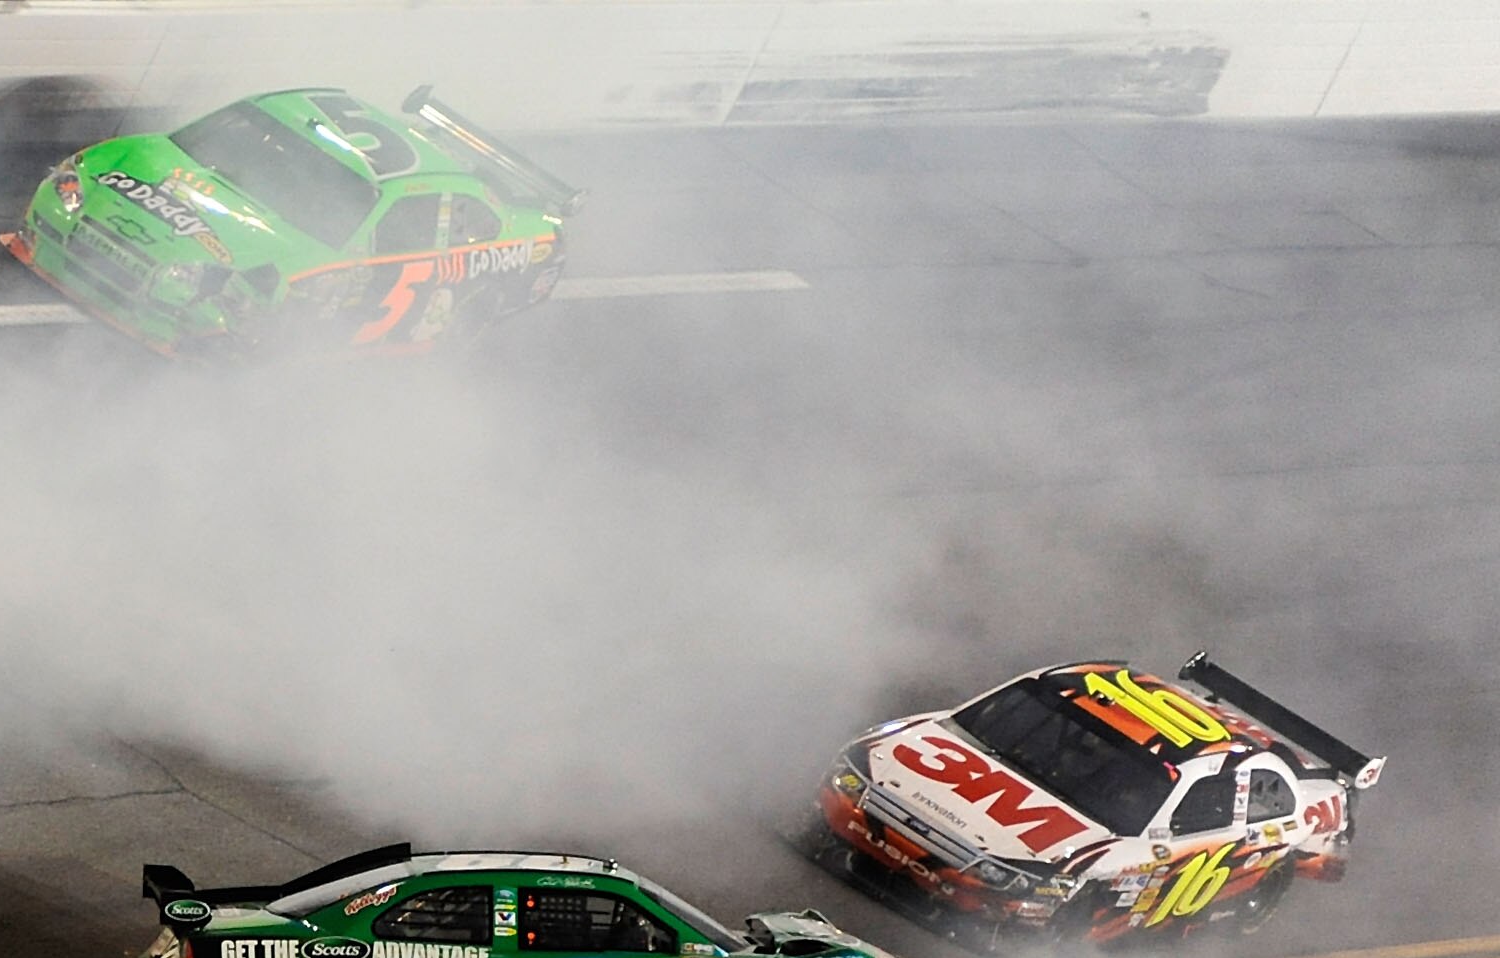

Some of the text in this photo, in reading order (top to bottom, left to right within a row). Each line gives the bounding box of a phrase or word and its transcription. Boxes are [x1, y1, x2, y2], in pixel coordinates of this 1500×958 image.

[306, 95, 420, 180] 5
[353, 261, 435, 345] 5
[1084, 669, 1232, 749] 16
[891, 736, 1090, 854] 3M
[847, 820, 956, 896] FUSION
[1144, 842, 1237, 929] 16
[171, 904, 204, 917] Scotts
[311, 943, 362, 957] Scotts
